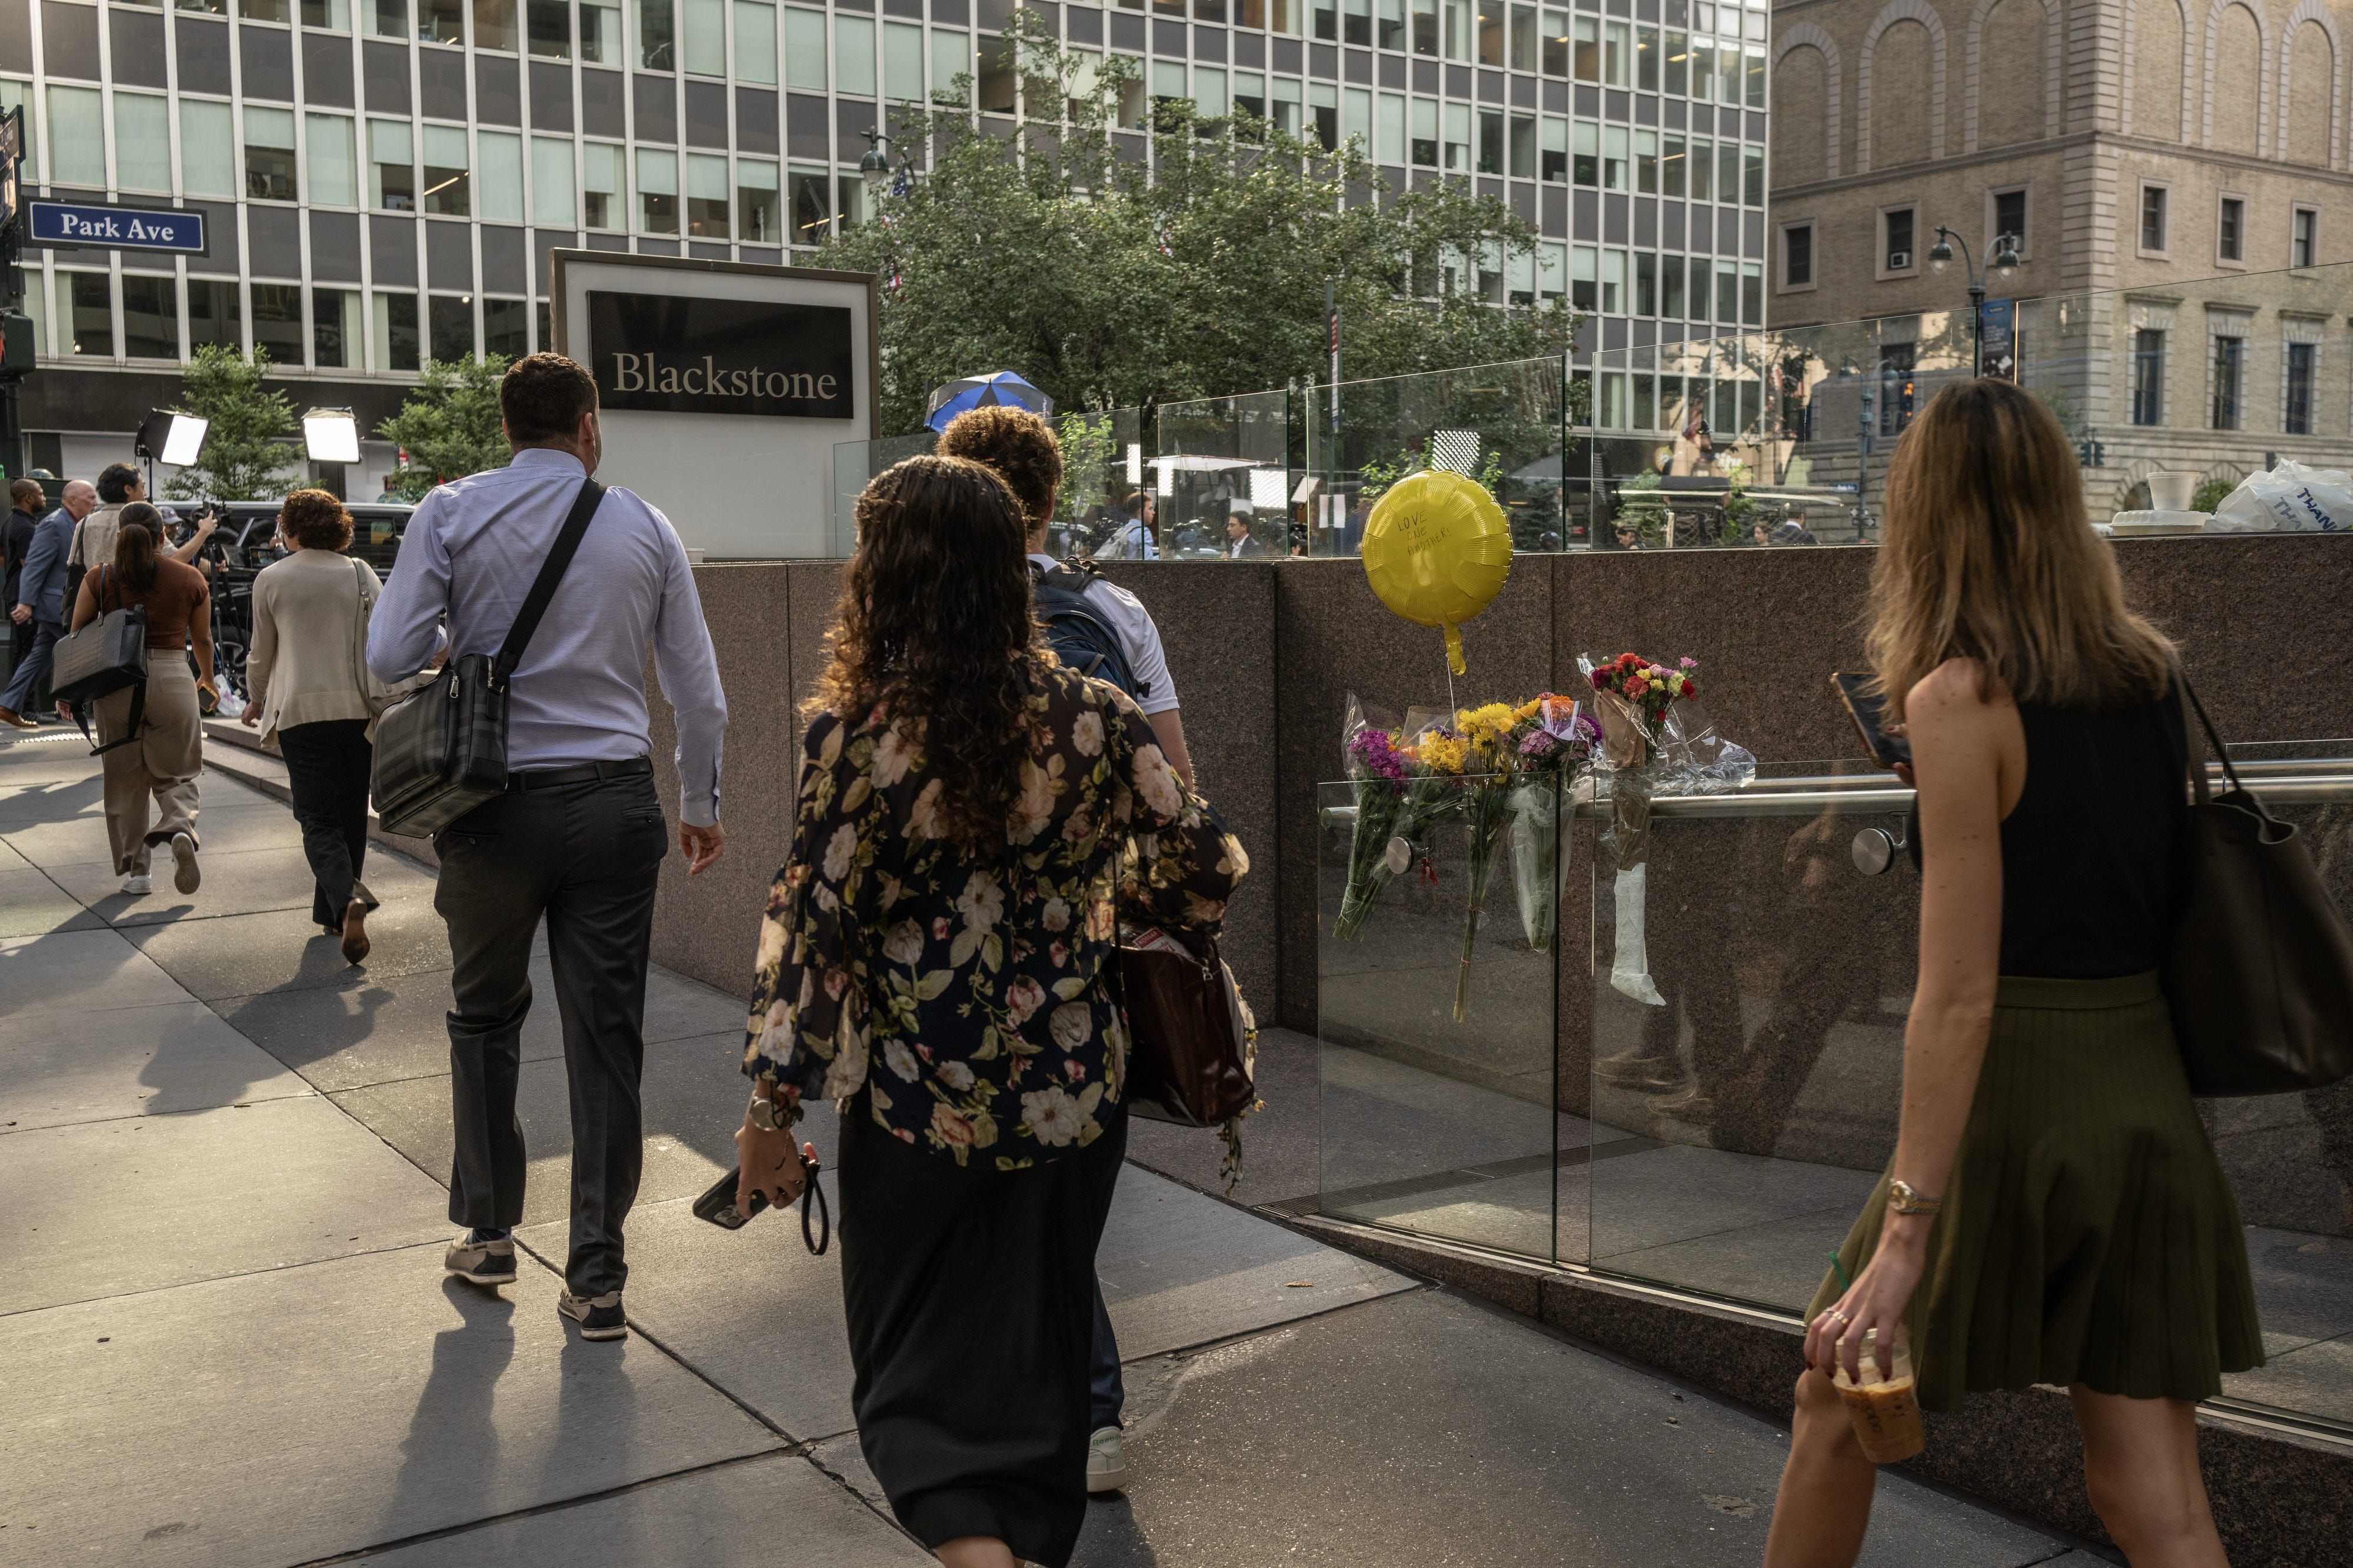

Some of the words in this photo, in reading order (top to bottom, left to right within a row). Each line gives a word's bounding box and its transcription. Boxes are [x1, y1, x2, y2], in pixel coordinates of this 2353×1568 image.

[61, 213, 121, 238] Park
[127, 218, 174, 242] Ave
[612, 352, 837, 400] Blackstone
[1398, 509, 1427, 532] LOVE
[1407, 526, 1427, 540] ONE
[1407, 527, 1452, 556] ANOTHER!
